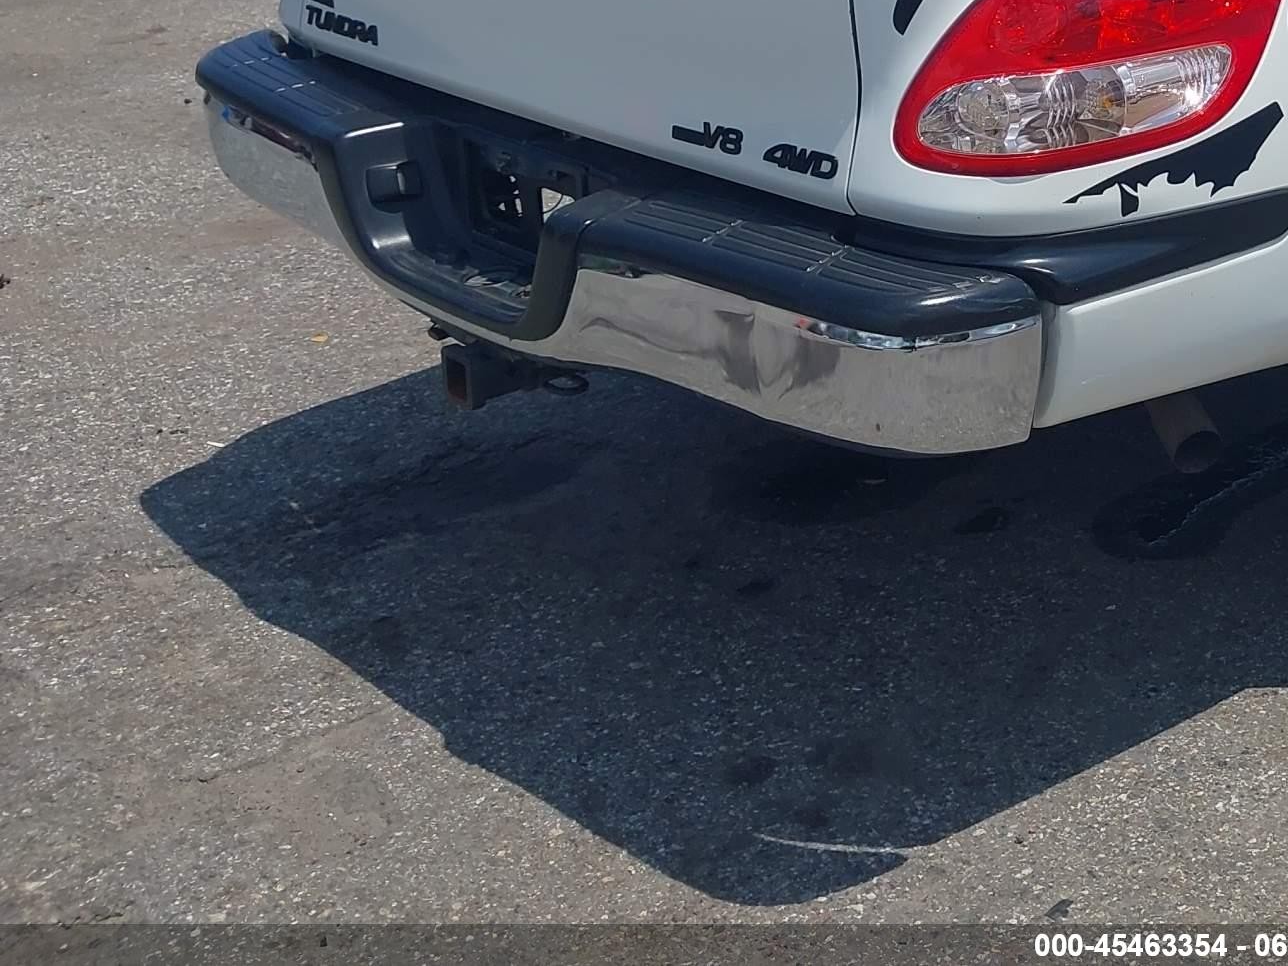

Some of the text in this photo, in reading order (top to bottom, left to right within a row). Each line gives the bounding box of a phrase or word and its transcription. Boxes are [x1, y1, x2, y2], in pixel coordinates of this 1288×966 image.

[305, 4, 379, 47] TUNDRA
[702, 121, 839, 180] V8 4WD
